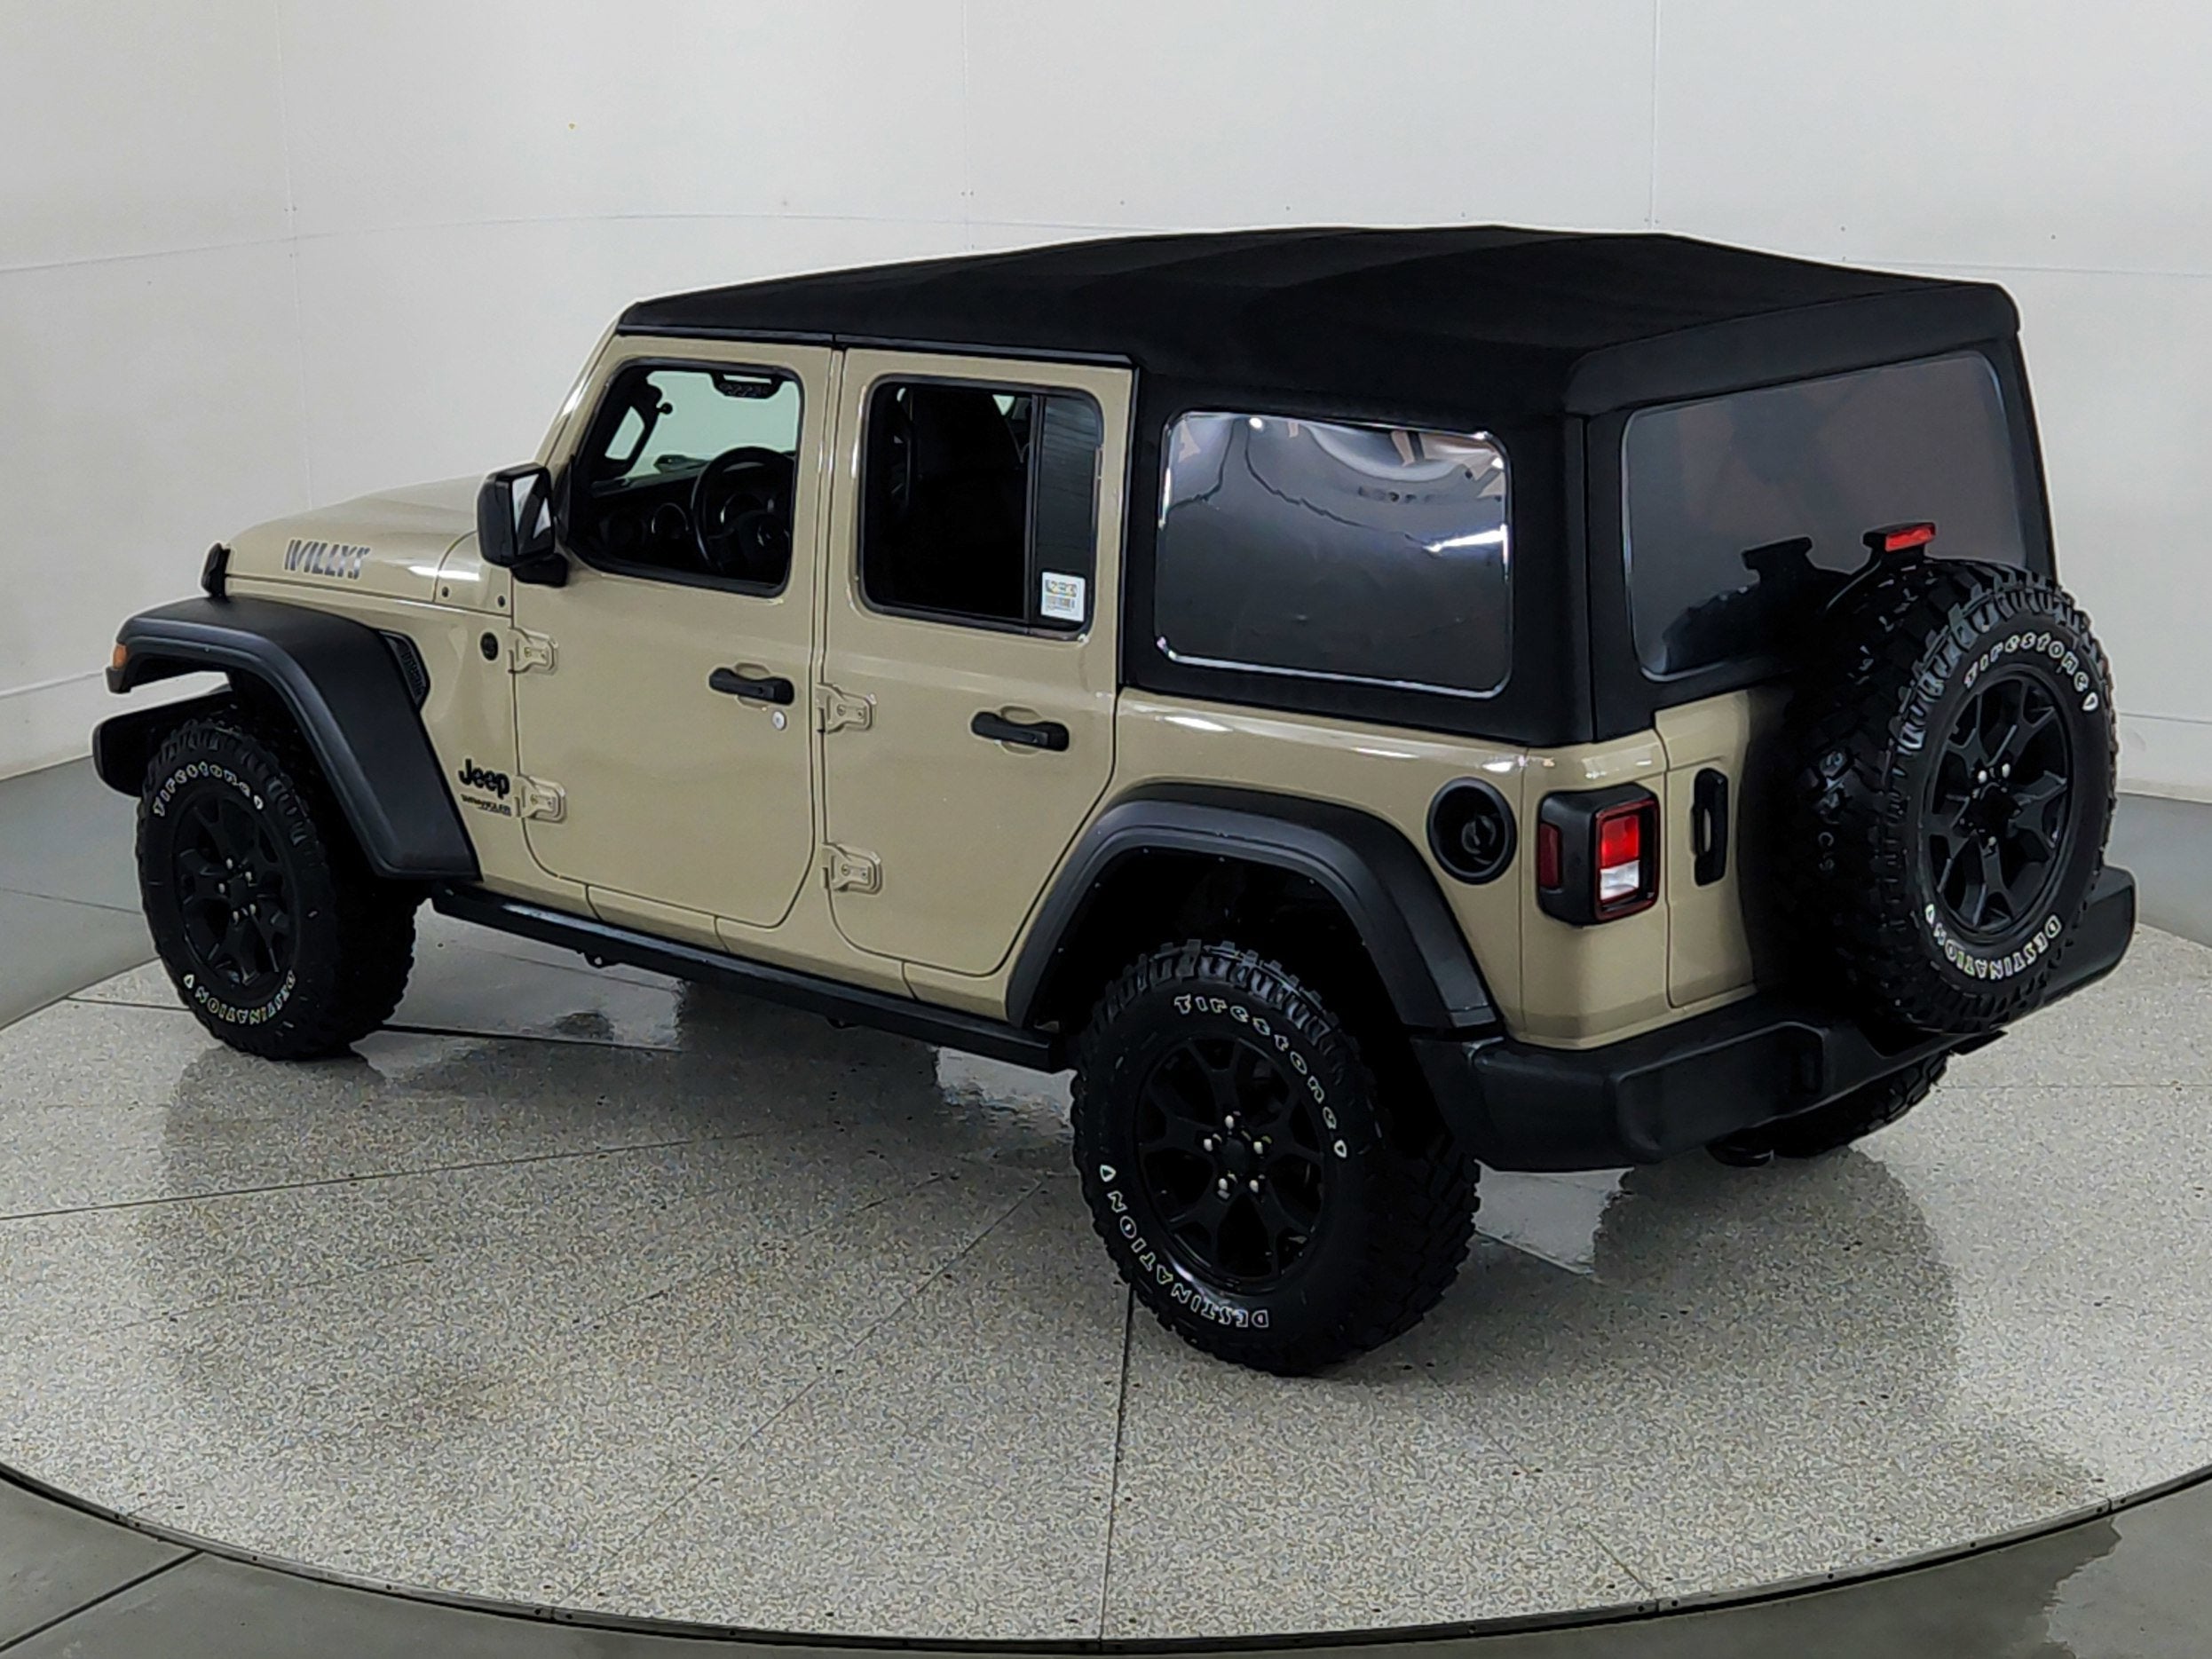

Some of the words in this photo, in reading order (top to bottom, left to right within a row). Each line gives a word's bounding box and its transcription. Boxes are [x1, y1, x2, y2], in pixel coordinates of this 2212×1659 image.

[284, 539, 370, 580] WILLYS
[1963, 631, 2090, 692] Firestone
[458, 758, 510, 800] Jeep
[1933, 913, 2062, 980] DESTINATION
[1173, 993, 1337, 1130] Firestone
[1107, 1190, 1269, 1328] DESTINATION
